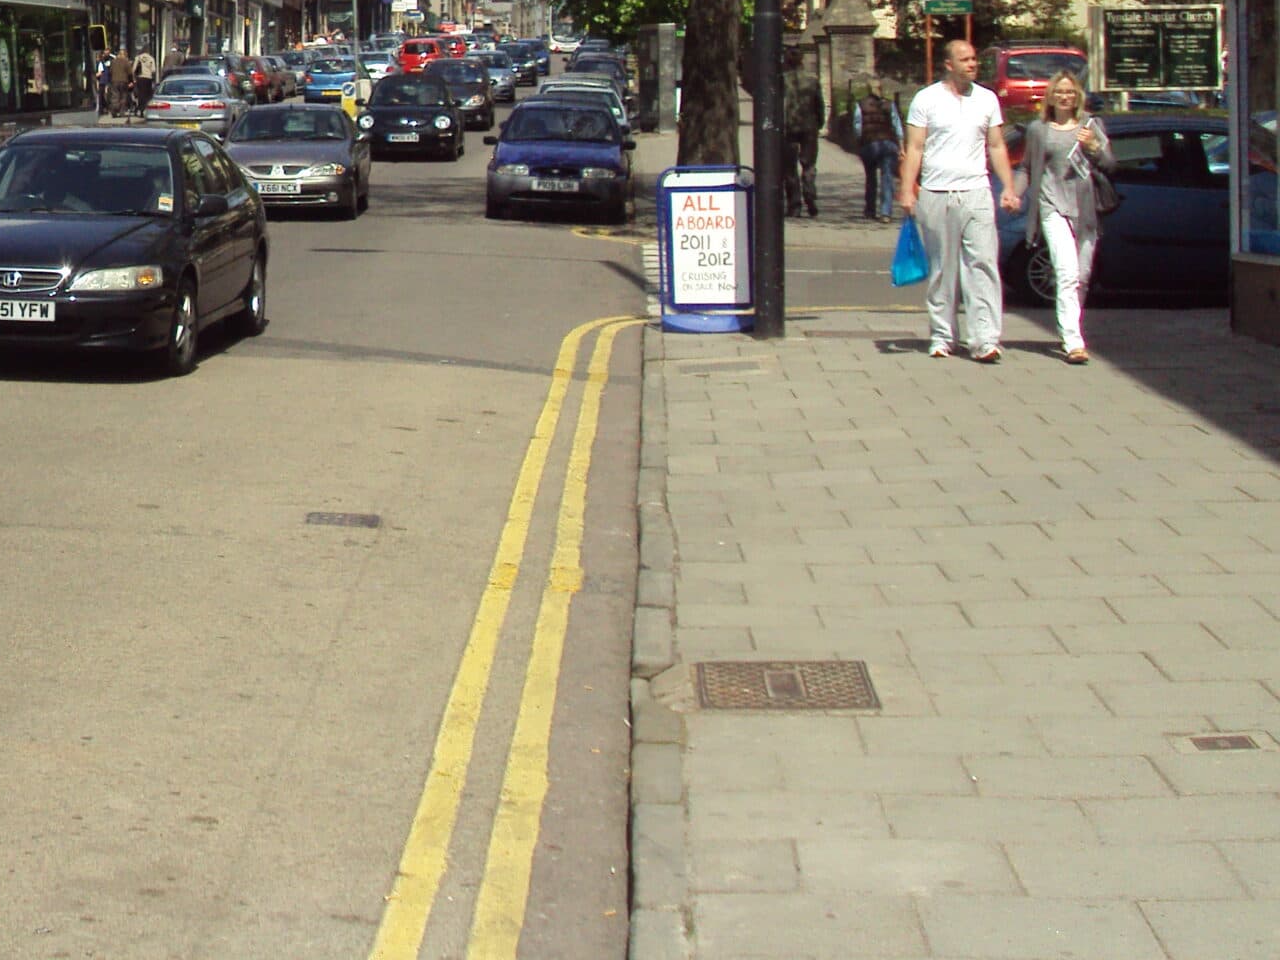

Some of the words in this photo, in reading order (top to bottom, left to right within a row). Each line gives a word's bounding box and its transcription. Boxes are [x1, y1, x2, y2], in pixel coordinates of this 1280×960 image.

[1180, 10, 1214, 22] Church
[682, 195, 720, 211] ALL
[680, 235, 711, 250] 2011
[698, 251, 733, 267] 2012
[682, 271, 727, 282] CRUISING
[19, 302, 49, 318] YFW
